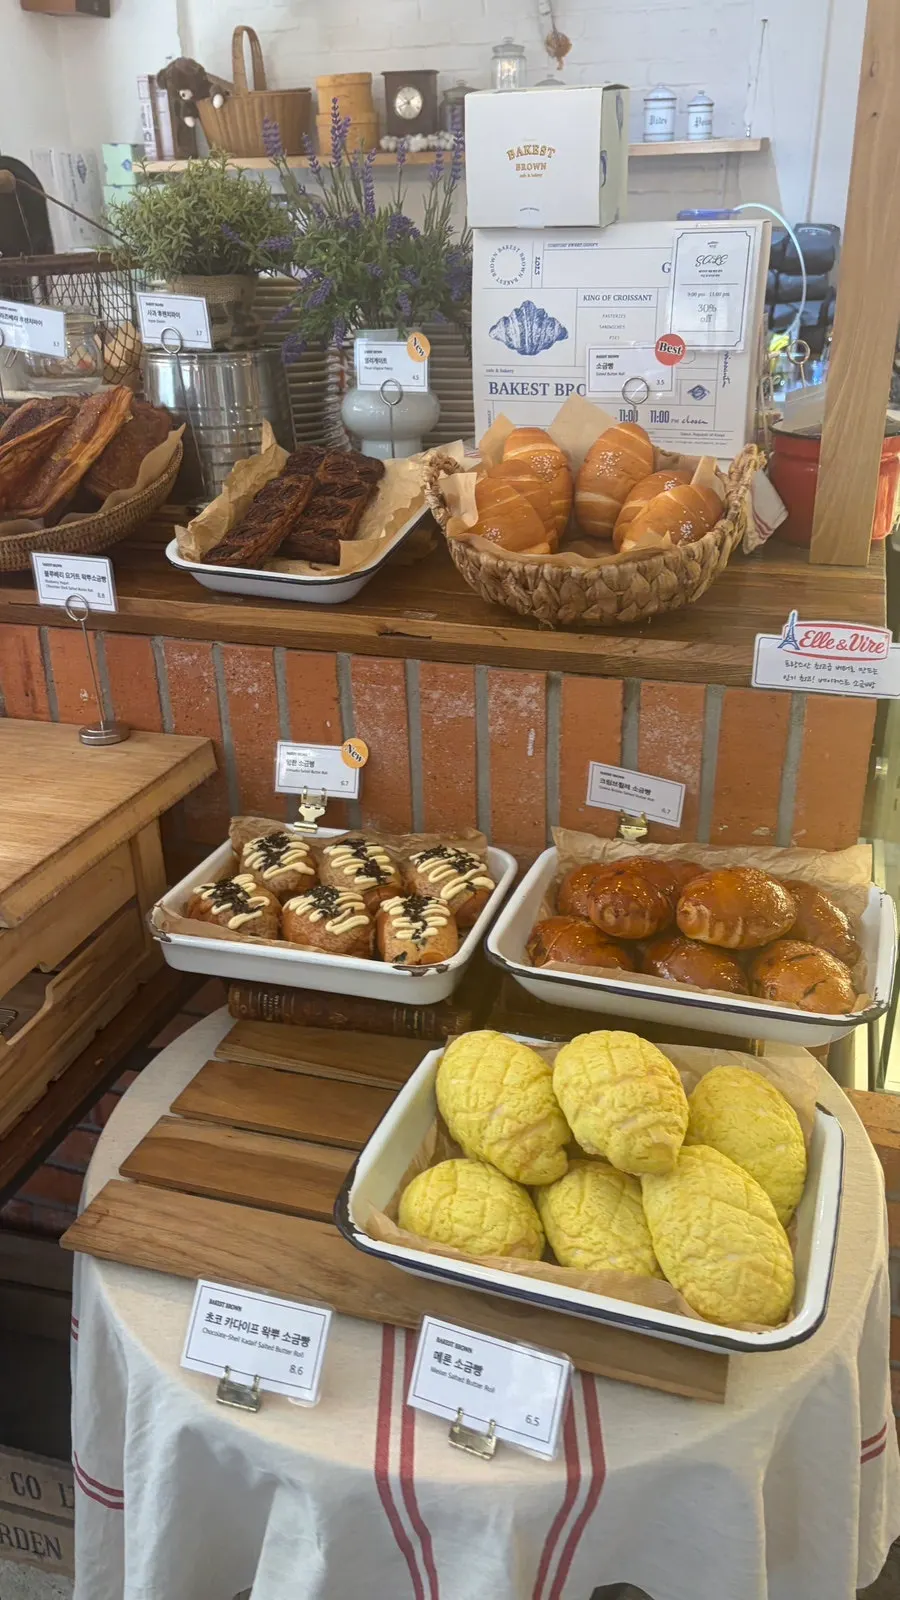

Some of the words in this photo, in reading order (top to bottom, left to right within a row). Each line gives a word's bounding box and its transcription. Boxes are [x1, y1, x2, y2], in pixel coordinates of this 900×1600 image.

[506, 144, 556, 160] BAKEST
[515, 162, 547, 172] BROWN
[695, 254, 728, 268] SALE
[613, 294, 652, 302] CROISSANT
[698, 304, 718, 313] 30%
[700, 314, 713, 323] off
[414, 336, 426, 356] New
[660, 342, 682, 354] Best
[488, 382, 550, 396] BAKEST
[554, 383, 586, 397] BRO
[650, 410, 670, 424] 11:00
[44, 570, 65, 579] 블루베리
[784, 660, 811, 669] 프랑스산
[814, 663, 832, 671] 최고급
[835, 665, 856, 673] 버터로
[858, 667, 879, 675] 만드는
[853, 680, 876, 689] 소금빵
[345, 744, 362, 762] New
[298, 760, 315, 768] 소금빵
[632, 785, 652, 796] 소금빵
[209, 1298, 225, 1308] BAKEST
[226, 1303, 242, 1312] BROWN
[204, 1312, 222, 1326] 초코
[224, 1316, 260, 1335] 카다이프
[262, 1326, 280, 1340] 왁뿌
[282, 1332, 311, 1348] 소금빵
[202, 1327, 240, 1344] Chocolate-Shell
[258, 1341, 274, 1351] Salted
[276, 1346, 292, 1354] Butter
[293, 1350, 304, 1358] Roll
[436, 1336, 454, 1348] BAKEST
[454, 1342, 472, 1354] BROWN
[289, 1364, 304, 1376] 8.6
[433, 1351, 452, 1367] 메론
[454, 1358, 484, 1377] 소금빵
[448, 1372, 464, 1384] Salted
[466, 1378, 483, 1390] Butter
[484, 1384, 496, 1394] Roll
[525, 1414, 540, 1427] 6.5
[10, 1471, 42, 1500] CO
